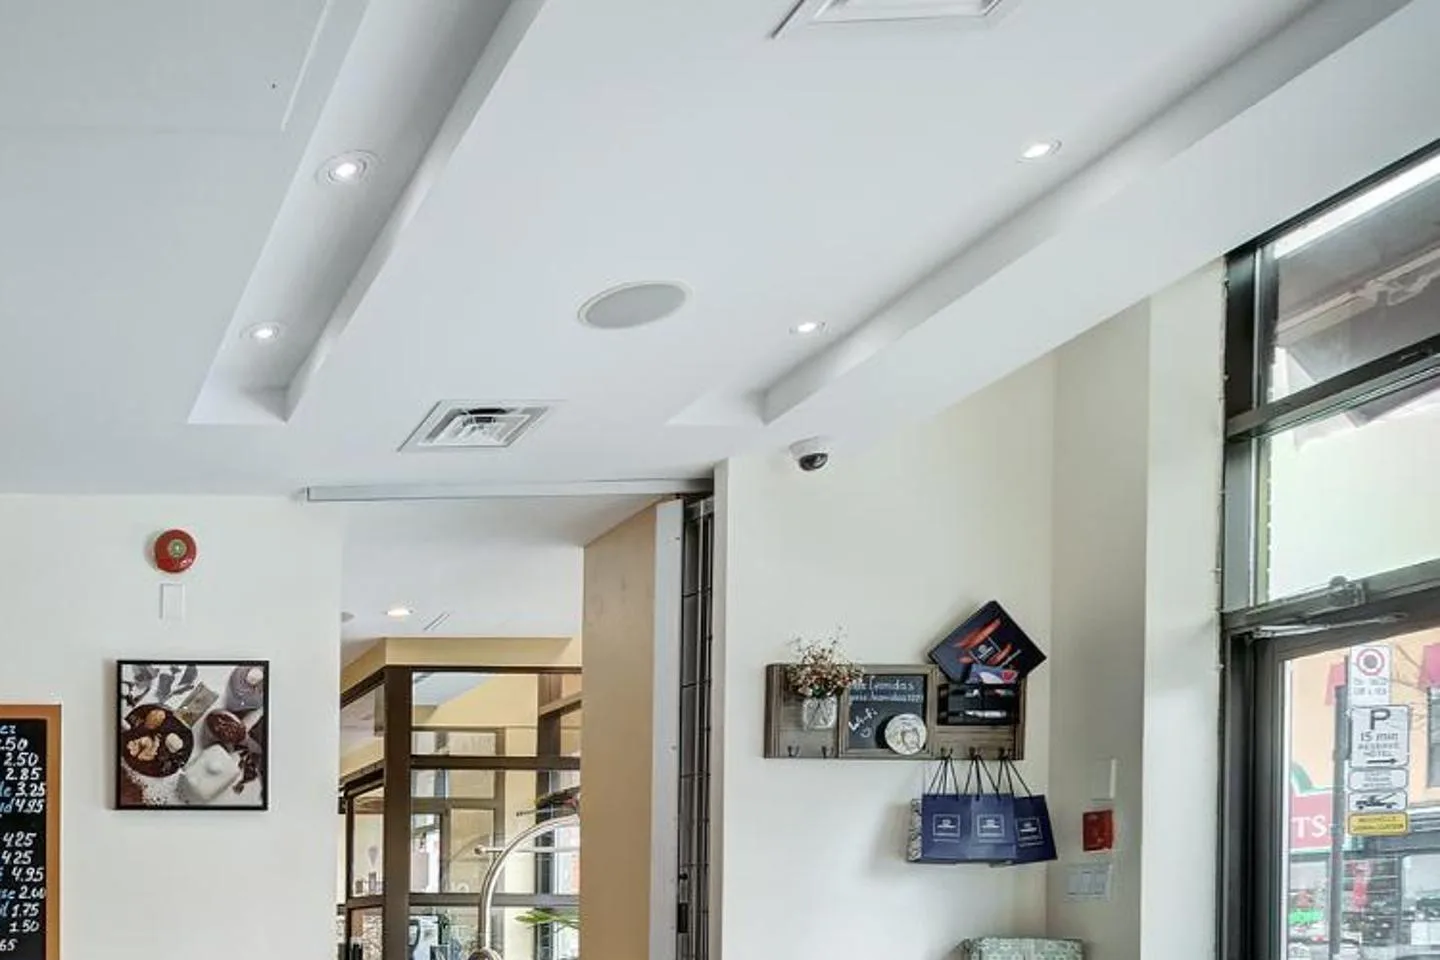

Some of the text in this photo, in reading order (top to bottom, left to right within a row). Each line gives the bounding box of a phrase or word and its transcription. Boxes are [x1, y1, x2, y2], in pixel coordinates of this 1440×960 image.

[1370, 708, 1391, 730] P
[1360, 732, 1399, 741] 15 min
[3, 752, 40, 767] 2.50
[5, 768, 42, 781] 2.85
[11, 866, 45, 882] 4.95
